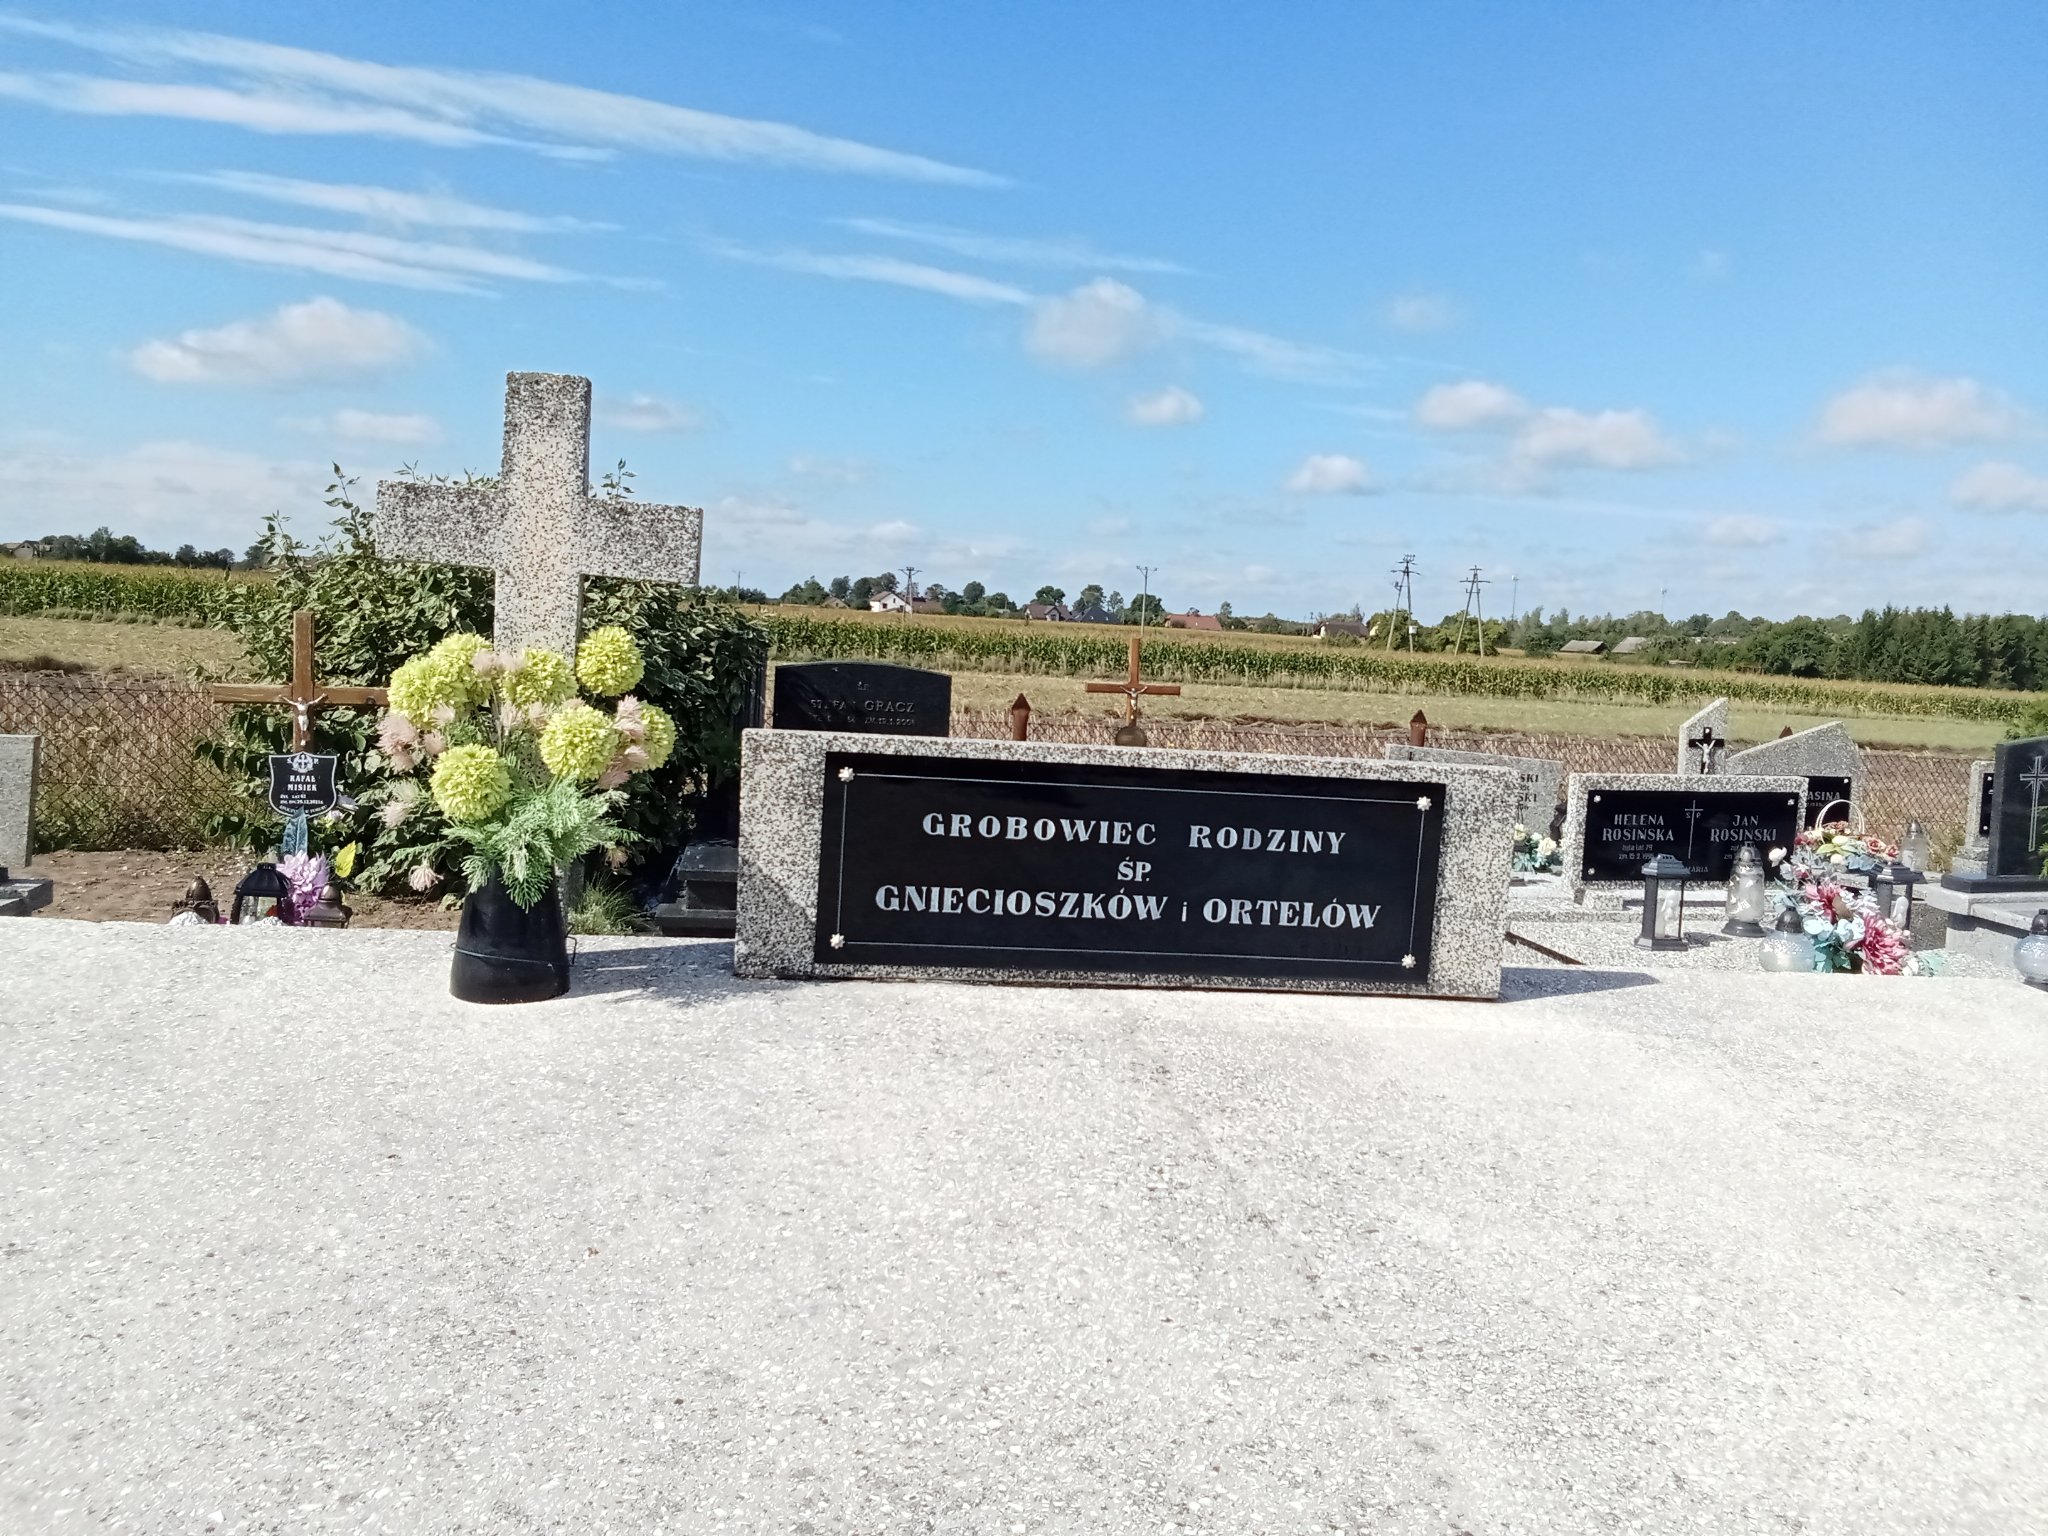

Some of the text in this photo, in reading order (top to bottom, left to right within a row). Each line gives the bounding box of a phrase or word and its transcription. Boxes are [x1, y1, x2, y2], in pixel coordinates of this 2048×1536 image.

[864, 699, 915, 713] GRACZ
[289, 775, 316, 783] RAFAŁ
[1614, 814, 1665, 826] HELENA
[1732, 814, 1760, 827] JAN
[922, 812, 1346, 855] GROBOWIEC RODZINY
[1602, 826, 1675, 842] ROSIŃSKA
[1116, 855, 1152, 883] ŚP.
[875, 883, 1169, 922] GNIECIOSZKÓW
[1202, 896, 1383, 930] ORTELÓW
